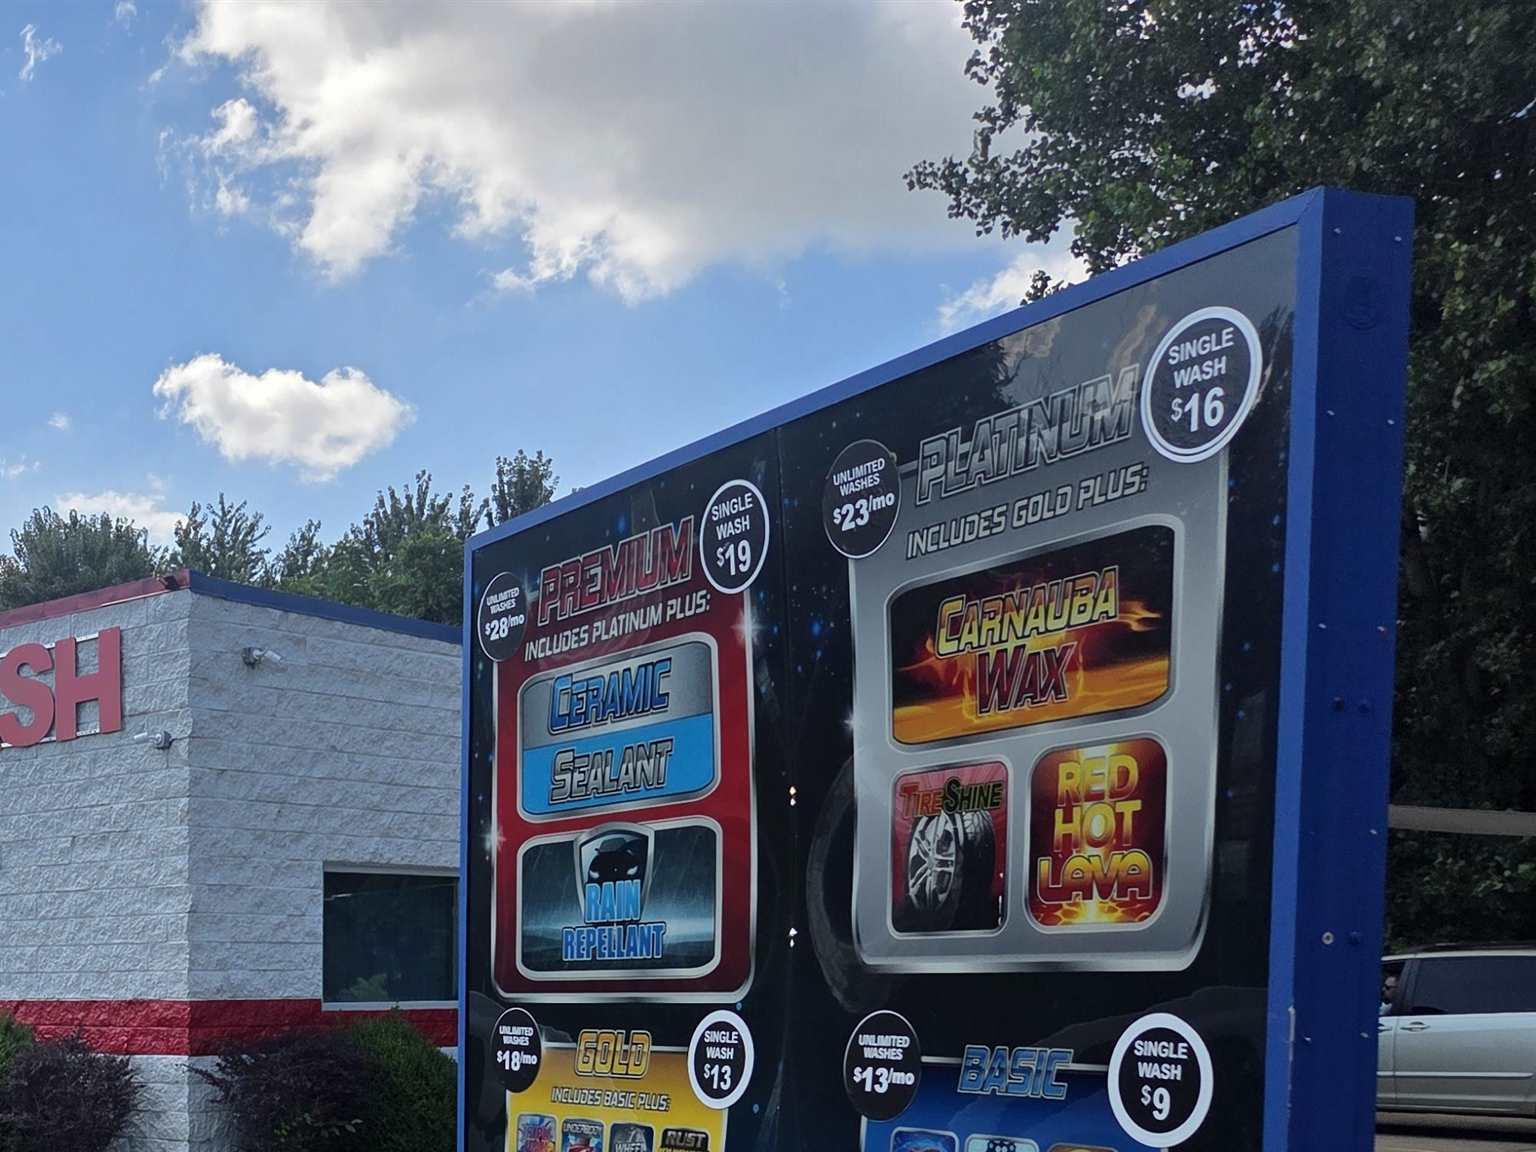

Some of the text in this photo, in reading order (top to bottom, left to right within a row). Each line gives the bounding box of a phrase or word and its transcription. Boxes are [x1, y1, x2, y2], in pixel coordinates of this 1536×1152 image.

[1167, 326, 1234, 364] SINGLE
[1173, 356, 1226, 389] WASH
[1170, 387, 1225, 433] $16
[915, 363, 1141, 506] PLATINUM
[832, 457, 885, 486] UNLIMITED
[839, 473, 880, 496] WASHES
[711, 493, 754, 521] SINGLE
[833, 493, 895, 532] $23/mo
[905, 461, 1150, 560] INCLUDES GOLD PLUS:
[715, 515, 751, 541] WASH
[537, 515, 694, 627] PREMIUM
[716, 538, 752, 576] $19
[486, 587, 520, 606] UNLIMITED
[490, 598, 516, 614] WASHES
[936, 565, 1119, 660] CARNAUBA
[485, 614, 525, 641] $28/mo
[524, 590, 711, 662] INCLUDES PLATINUM PLUS:
[976, 641, 1077, 717] WAX
[549, 658, 672, 735] CERAMIC
[549, 738, 674, 805] SEALANT
[1057, 754, 1140, 808] RED
[1053, 800, 1142, 854] HOT
[1037, 849, 1154, 905] LAVA
[584, 879, 641, 923] RAIN
[562, 922, 666, 961] REPELLANT
[499, 1025, 533, 1037] UNLIMITED
[502, 1036, 530, 1046] WASHES
[703, 1030, 739, 1044] SINGLE
[858, 1034, 910, 1049] UNLIMITED
[497, 1050, 538, 1072] $18/mo
[575, 1028, 652, 1079] GOLD
[706, 1047, 734, 1060] WASH
[864, 1047, 904, 1061] WASHES
[1134, 1040, 1188, 1059] SINGLE
[704, 1064, 732, 1090] $13
[853, 1066, 914, 1094] $13/mo
[957, 1044, 1074, 1100] BASIC
[1138, 1062, 1182, 1081] WASH
[551, 1086, 671, 1112] INCLUDES BASIC PLUS:
[1140, 1086, 1171, 1121] $9
[665, 1130, 706, 1148] RUST
